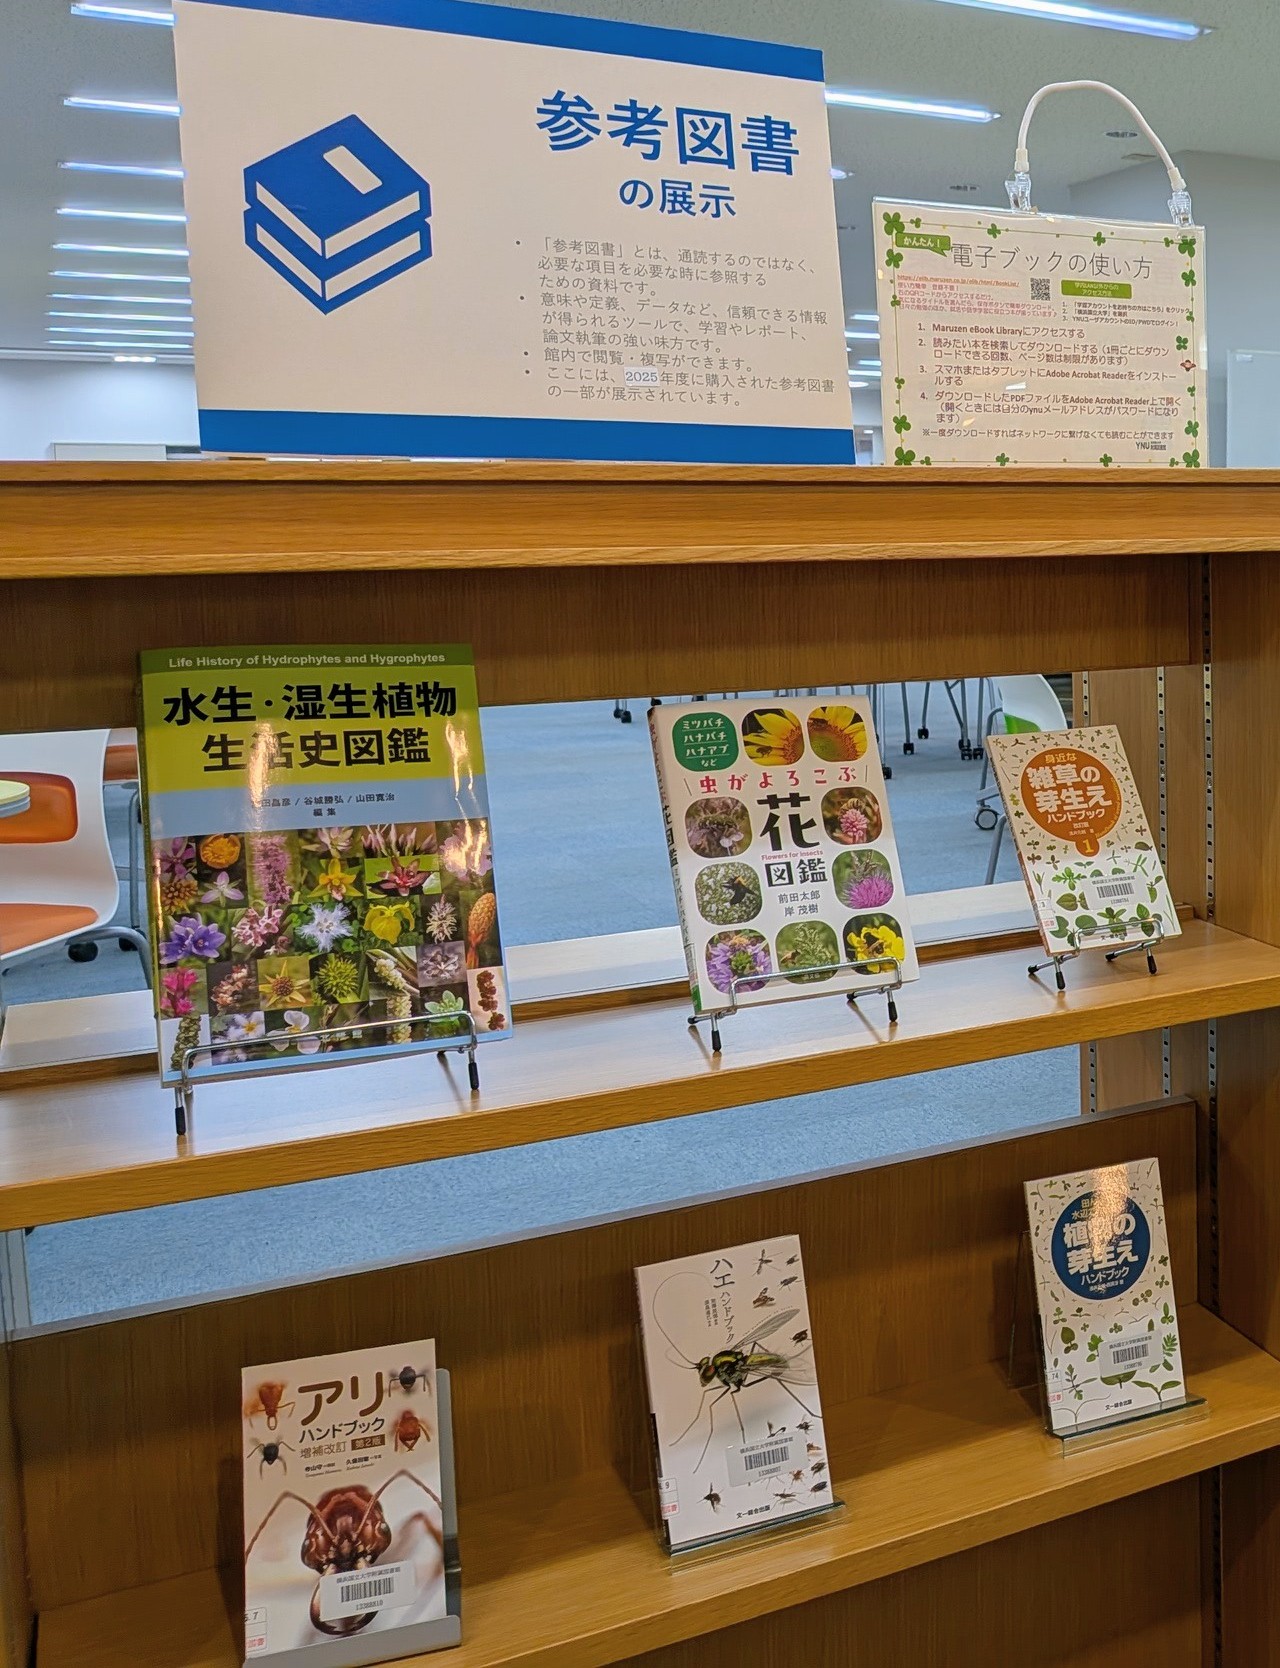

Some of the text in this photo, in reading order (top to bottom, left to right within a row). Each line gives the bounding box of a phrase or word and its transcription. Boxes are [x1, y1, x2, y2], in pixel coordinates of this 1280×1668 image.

[536, 89, 800, 176] 参考図書
[618, 178, 737, 218] の展示
[545, 236, 816, 274] 「参考図書」とは、通読するのではなく、
[951, 243, 1153, 280] 電子ブックの使い方
[537, 256, 767, 288] 必要な項目を必要な時に参照する
[538, 274, 657, 298] ための資料です。
[540, 292, 829, 327] 意味や定義、データなど、信頼できる情報
[542, 311, 808, 342] が得られるツールで、学習やレポート、
[918, 322, 1086, 339] 1. Maruzen eBook Libraryにアクセスする
[542, 328, 722, 354] 論文執筆の強い味方です。
[918, 338, 927, 347] 2.
[544, 348, 754, 373] 館内で閲覧・複写ができます。
[919, 365, 928, 374] 3.
[1071, 370, 1101, 380] Acrobat
[934, 376, 964, 387] ルする
[547, 384, 742, 408] の一部が展示されています。
[920, 392, 928, 401] 4.
[1094, 395, 1124, 405] Acrobat
[935, 413, 961, 424] ます）
[1135, 441, 1150, 451] YNU
[168, 652, 446, 669] Life History of Hydrophytes and Hygrophytes
[162, 681, 458, 726] 水生・湿生植物
[681, 717, 725, 730] ミツバチ
[683, 730, 728, 743] ハナバチ
[201, 727, 432, 773] 生活史図鑑
[685, 744, 729, 757] ハナアブ
[1045, 752, 1077, 764] 身近な
[700, 757, 718, 768] など
[699, 766, 858, 794] 虫がよろこぶ
[1026, 763, 1101, 790] 雑草の
[1033, 785, 1113, 813] 芽生え
[757, 792, 821, 851] 花
[1047, 808, 1105, 824] ハンドブック
[761, 852, 789, 861] Flowers
[800, 849, 824, 857] Insects
[1082, 839, 1095, 853] 1
[765, 858, 828, 887] 図鑑
[778, 890, 821, 904] 前田太郎
[1066, 1239, 1139, 1276] 芽生え
[709, 1258, 736, 1289] ハエ
[1080, 1266, 1130, 1286] ハンドブック
[720, 1291, 735, 1344] ハンドブック
[297, 1371, 385, 1427] アリ
[298, 1417, 385, 1444] ハンドブック
[299, 1440, 347, 1459] 増補改訂
